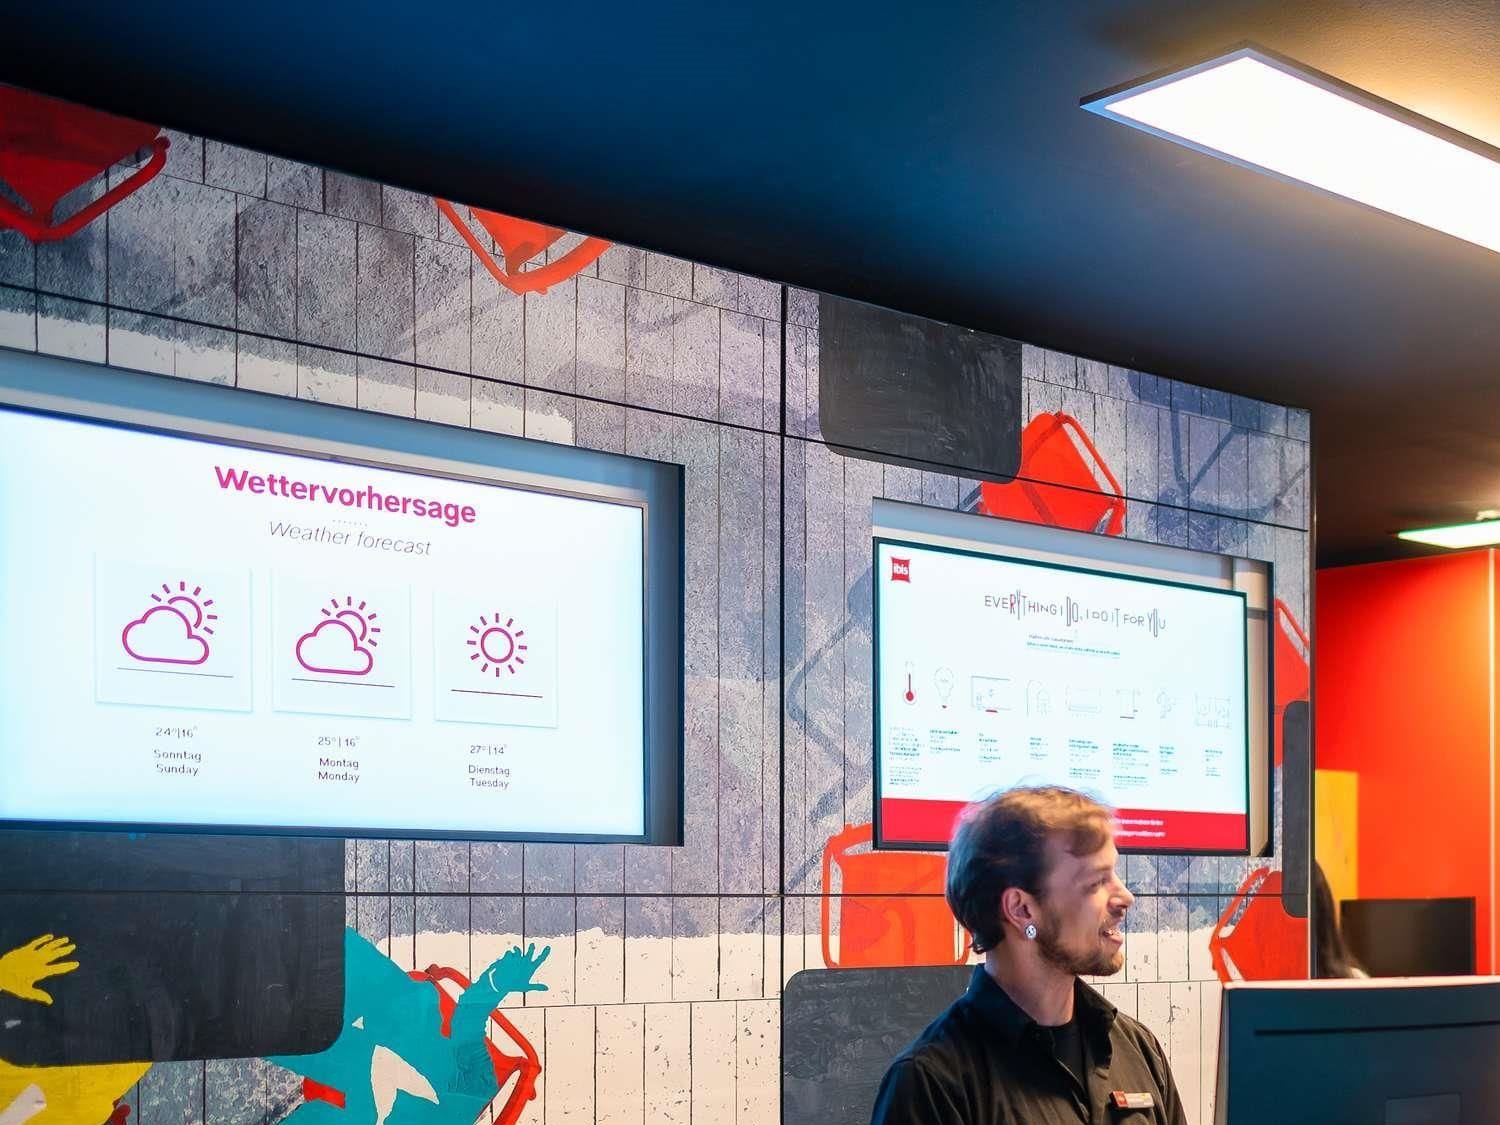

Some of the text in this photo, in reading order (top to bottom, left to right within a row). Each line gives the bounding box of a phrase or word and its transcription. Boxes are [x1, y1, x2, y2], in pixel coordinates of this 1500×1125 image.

[214, 465, 477, 528] Wettervorhersage
[268, 521, 432, 556] Weather forecast
[984, 588, 1057, 621] EVERYTHING
[1123, 613, 1145, 627] FOR
[1146, 607, 1167, 638] YOU
[153, 749, 202, 762] Sonntag
[319, 757, 360, 769] Montag
[156, 763, 199, 777] Sunday
[468, 764, 511, 777] Dienstag
[318, 771, 361, 784] Monday
[469, 778, 510, 790] Tuesday
